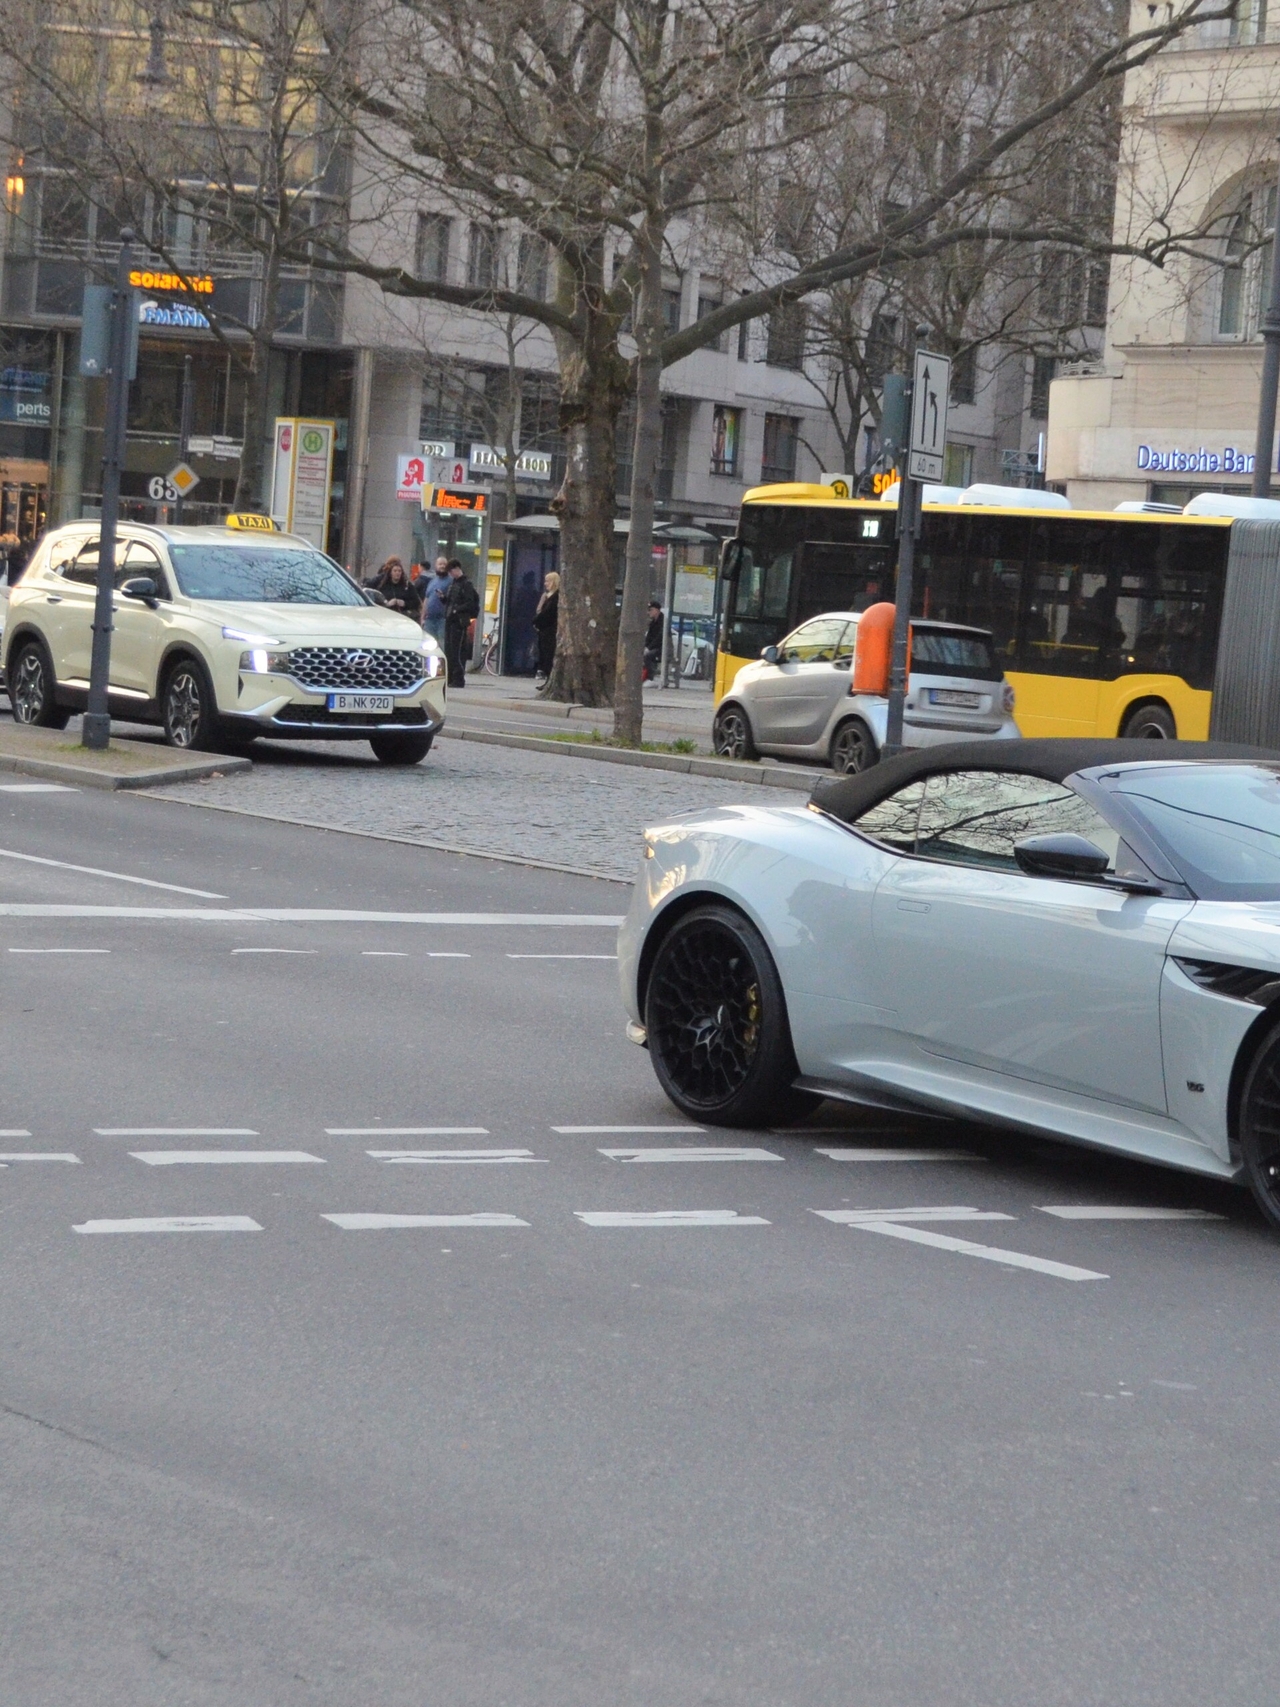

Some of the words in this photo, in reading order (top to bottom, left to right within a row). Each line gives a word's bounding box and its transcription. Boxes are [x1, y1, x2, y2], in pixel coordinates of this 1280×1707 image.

[1138, 445, 1221, 473] Deutsche
[240, 516, 268, 529] TAXI
[339, 696, 346, 708] B
[353, 696, 367, 709] NK
[369, 697, 389, 709] 920
